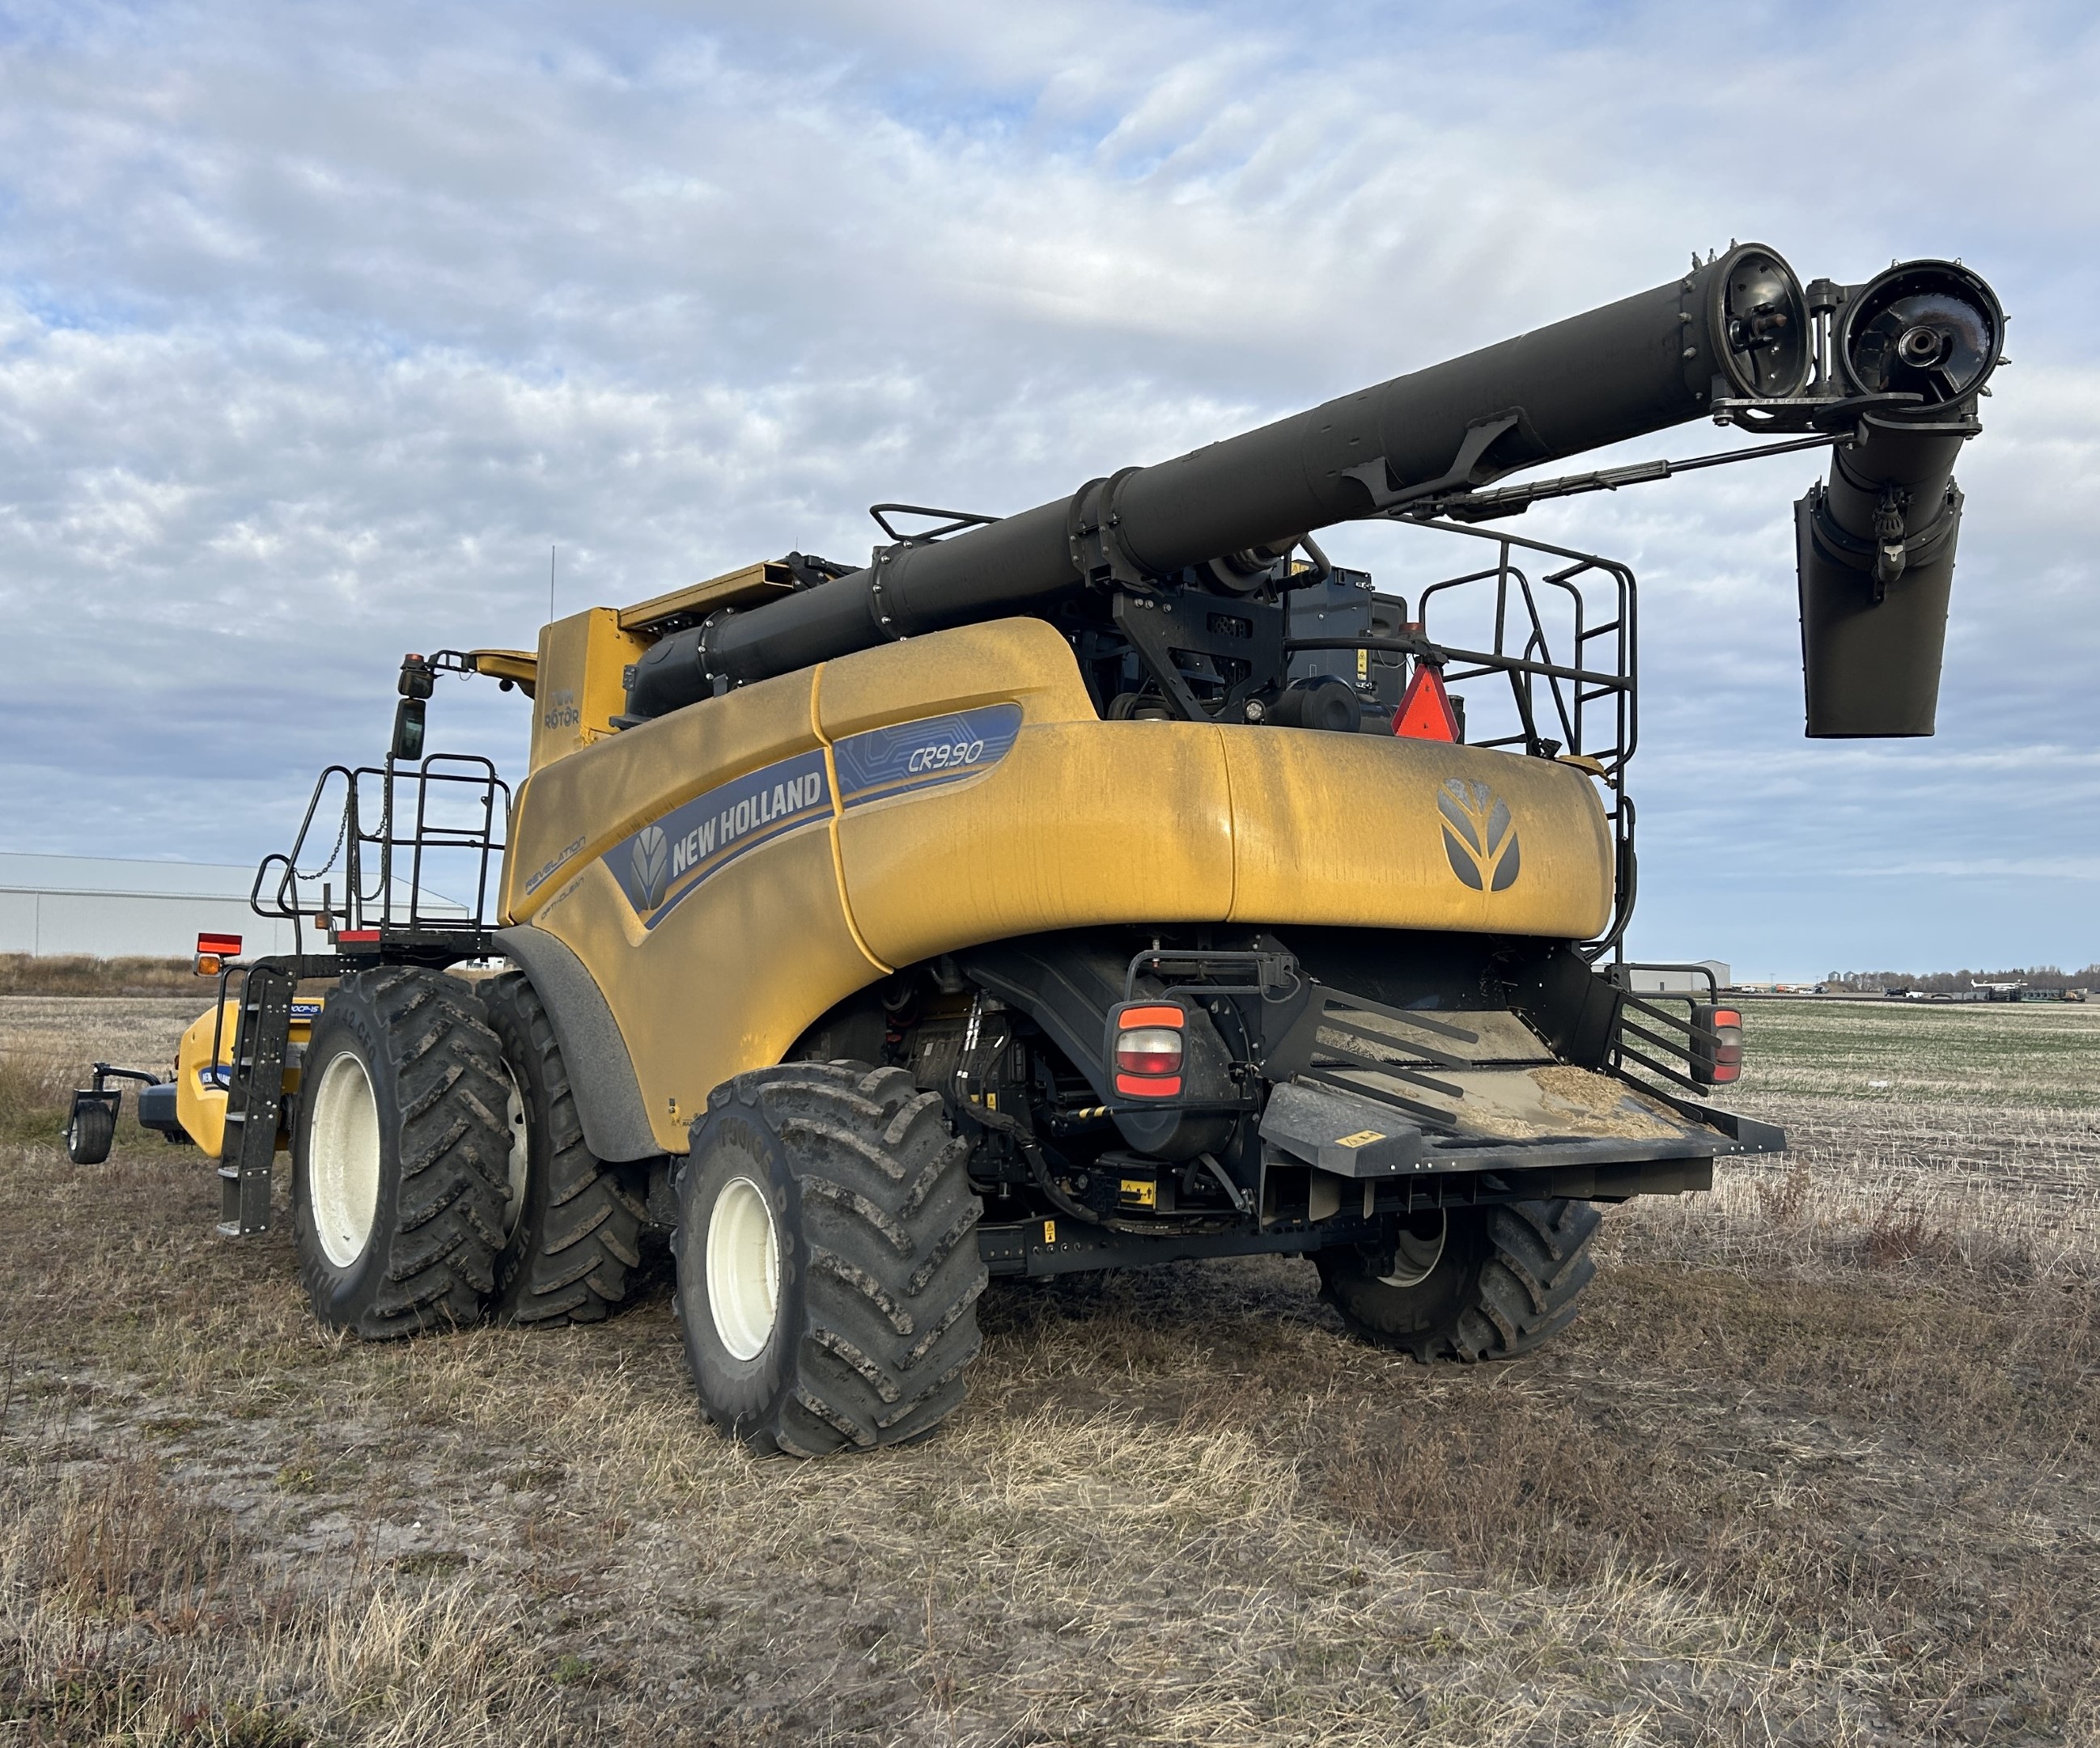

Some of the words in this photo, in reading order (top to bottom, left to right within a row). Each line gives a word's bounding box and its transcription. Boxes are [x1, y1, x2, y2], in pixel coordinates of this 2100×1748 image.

[545, 706, 579, 730] ROTOR
[908, 740, 984, 773] CR9.90
[672, 816, 717, 878] NEW
[720, 771, 821, 846] HOLLAND
[524, 835, 587, 892] REVELATION
